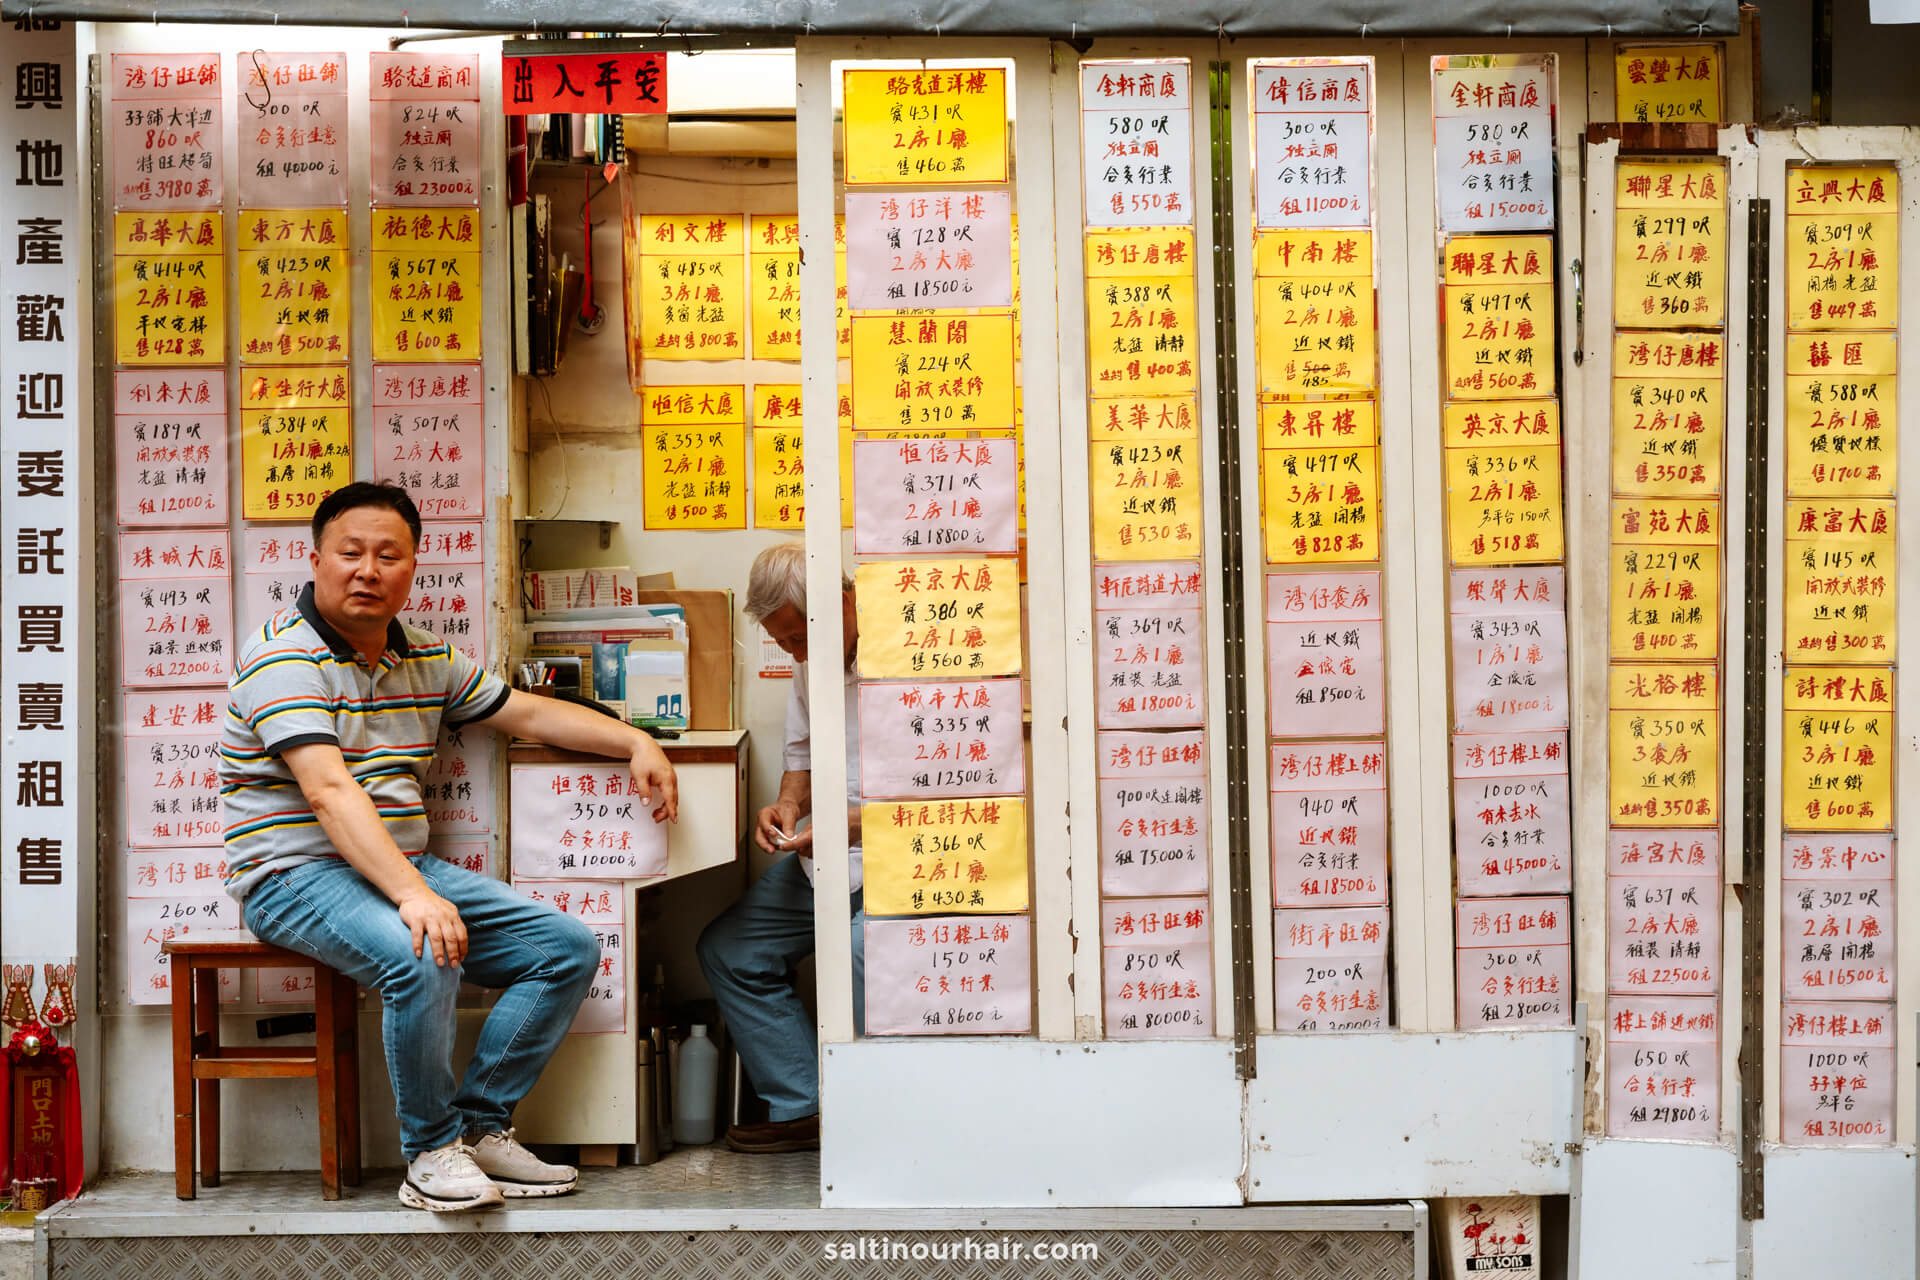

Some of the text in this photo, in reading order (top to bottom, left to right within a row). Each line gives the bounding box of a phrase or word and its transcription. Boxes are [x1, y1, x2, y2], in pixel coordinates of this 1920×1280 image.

[513, 58, 660, 105] 出入平安
[1110, 116, 1168, 135] 580呎
[1283, 120, 1337, 139] 300呎
